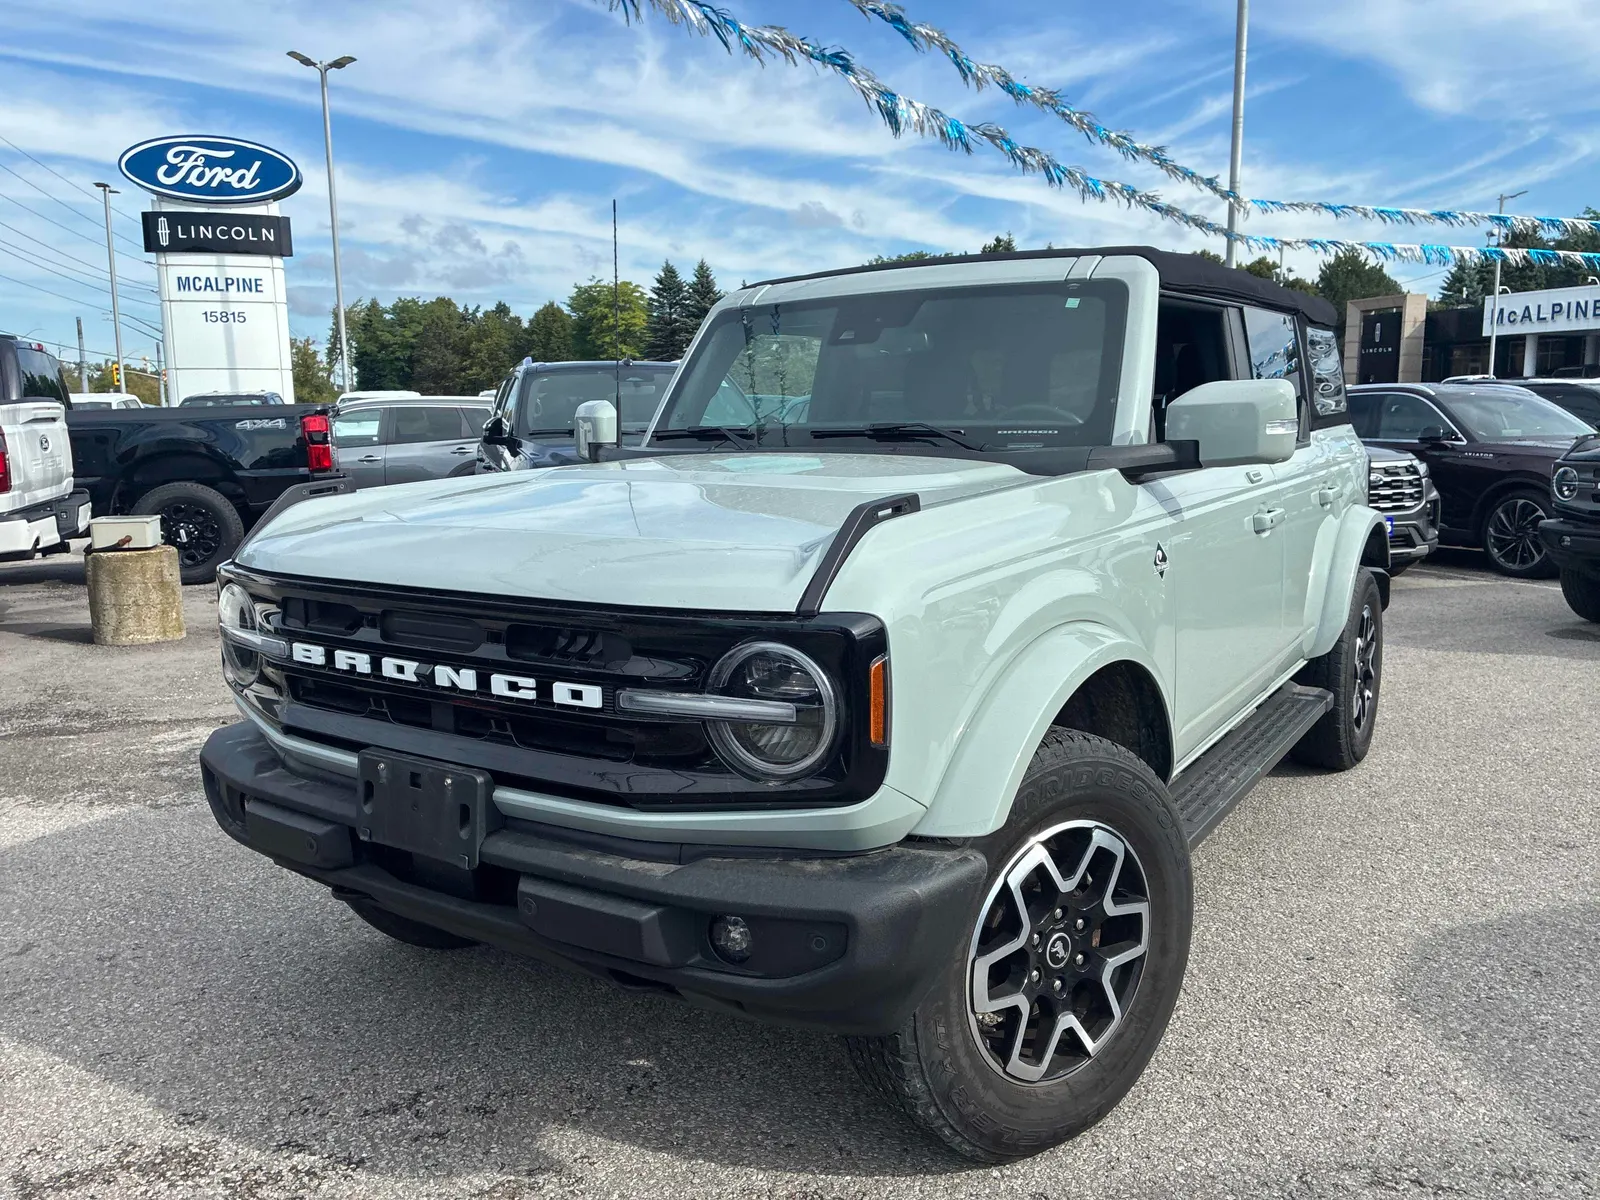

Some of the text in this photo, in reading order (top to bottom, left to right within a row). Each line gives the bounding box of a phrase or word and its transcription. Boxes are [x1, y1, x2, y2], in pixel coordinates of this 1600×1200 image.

[157, 145, 262, 190] Ford
[177, 224, 275, 242] LINCOLN
[177, 276, 264, 293] MCALPINE
[202, 311, 247, 323] 15815
[292, 641, 603, 709] BRONCO
